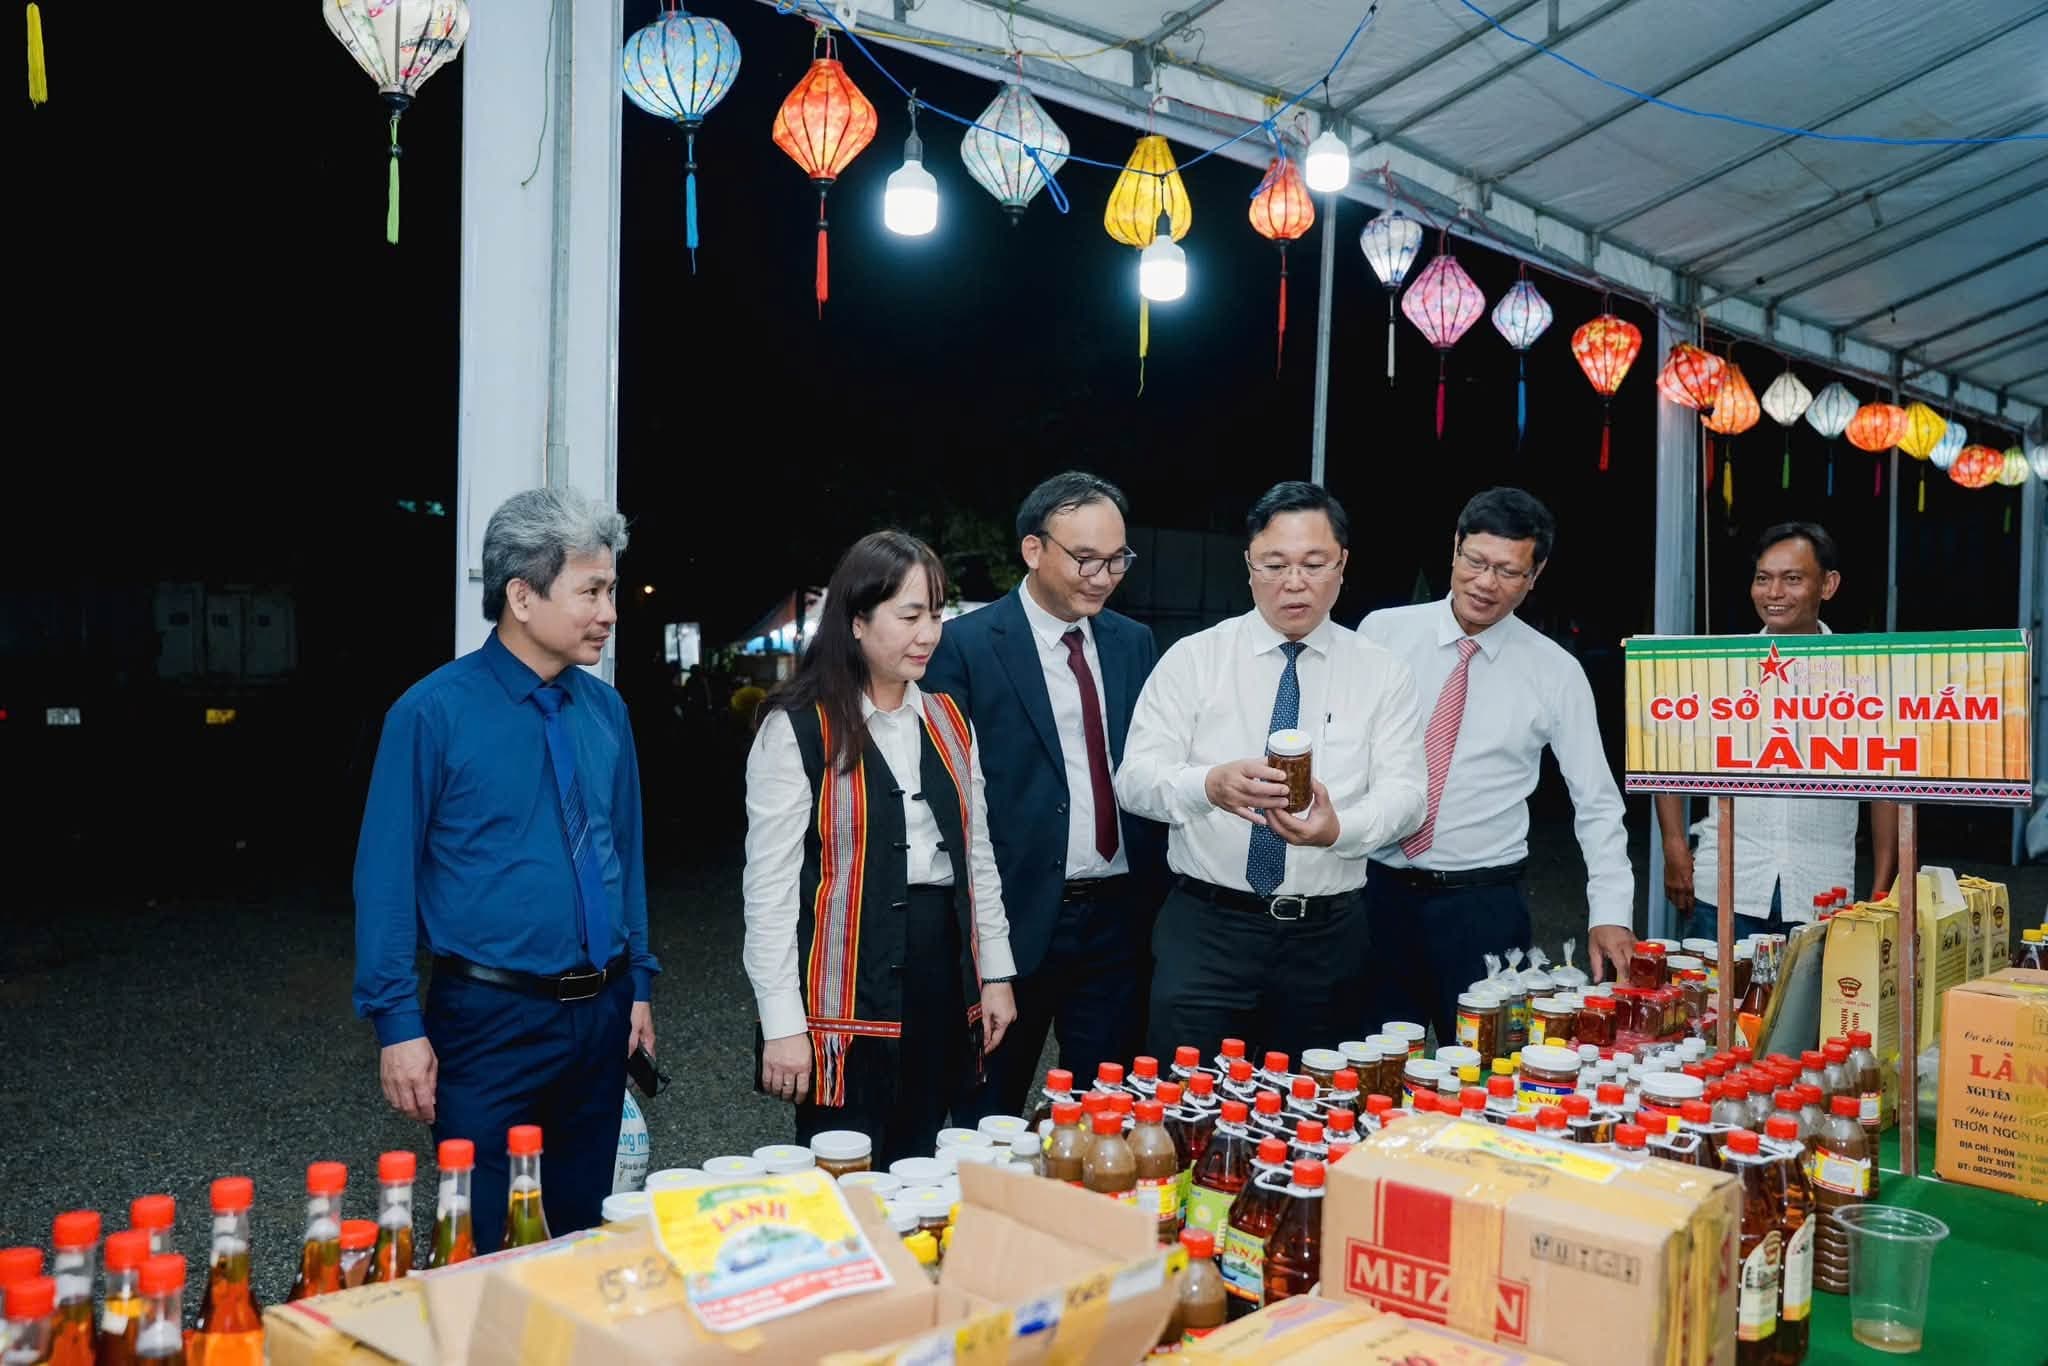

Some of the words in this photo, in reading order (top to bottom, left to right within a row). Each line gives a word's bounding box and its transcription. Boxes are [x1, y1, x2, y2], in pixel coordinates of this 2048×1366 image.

[1650, 693, 1700, 721] CƠ
[1711, 689, 1760, 721] SỞ
[1773, 691, 1884, 721] NƯỚC
[1898, 686, 1999, 721] MẮM
[1716, 727, 1918, 772] LÀNH
[1952, 1118, 1989, 1134] THƠM
[1353, 1252, 1521, 1330] MEIZN
